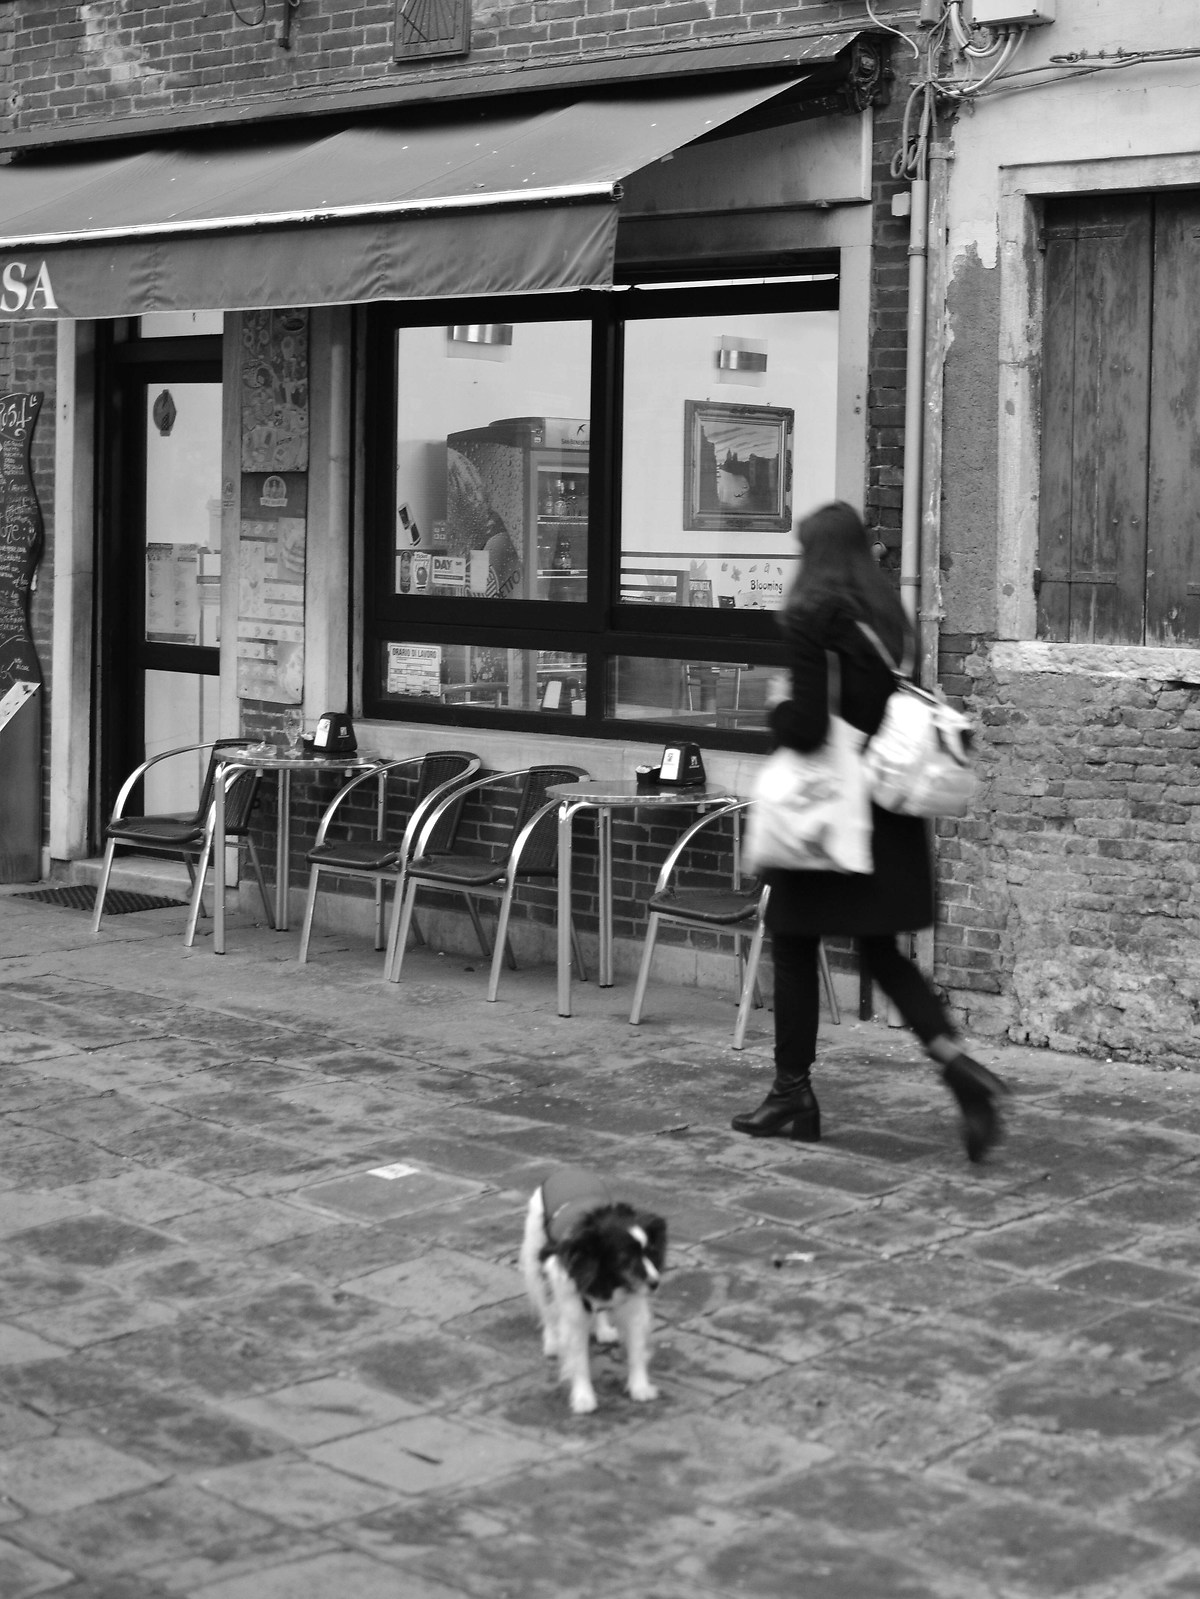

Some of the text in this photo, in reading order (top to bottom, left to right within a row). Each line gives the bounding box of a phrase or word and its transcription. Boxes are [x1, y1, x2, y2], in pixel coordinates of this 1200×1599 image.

[0, 260, 59, 312] SA
[434, 559, 452, 570] DAY
[750, 579, 783, 594] Blooming
[392, 647, 411, 657] ORARIO
[417, 649, 437, 659] LAVORO
